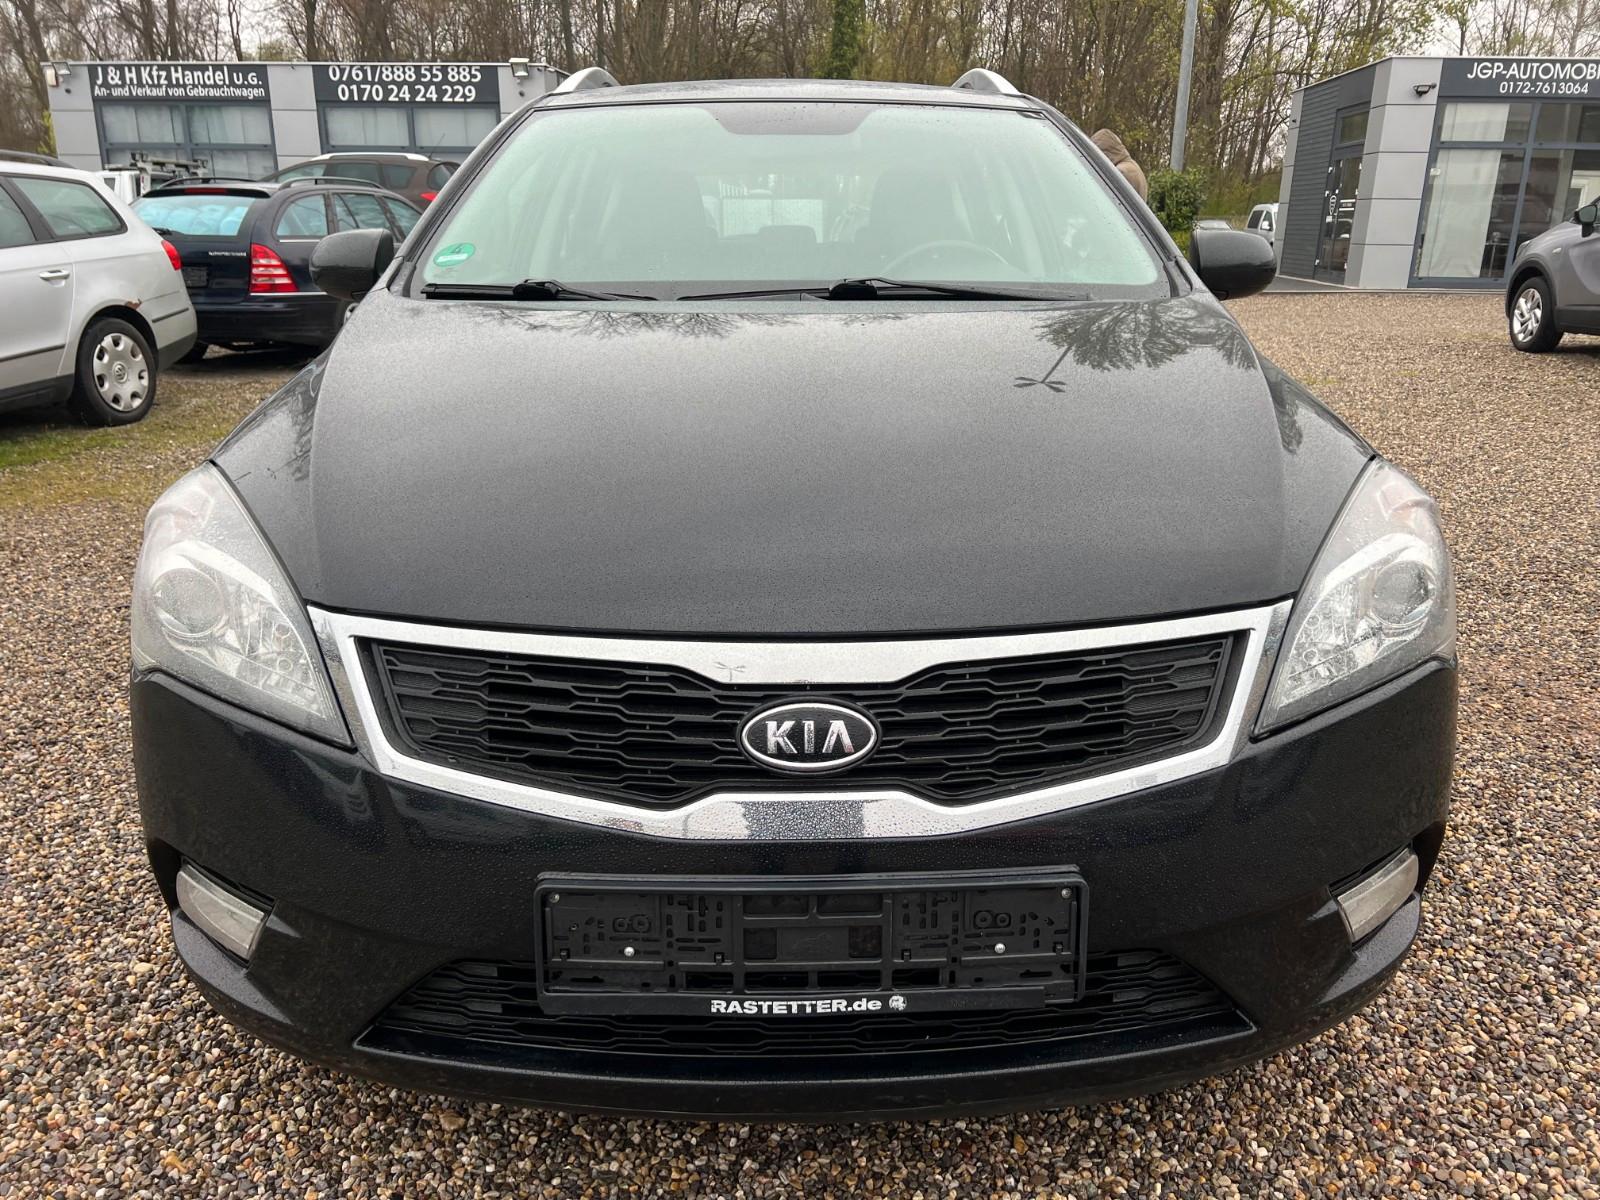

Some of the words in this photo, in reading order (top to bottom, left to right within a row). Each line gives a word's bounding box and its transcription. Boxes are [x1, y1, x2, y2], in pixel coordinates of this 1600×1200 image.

[96, 66, 103, 85] J
[107, 65, 122, 85] &
[124, 66, 138, 85] H
[140, 65, 168, 85] Kfz
[170, 65, 229, 85] Handel
[328, 65, 416, 82] 0761/888
[420, 65, 443, 82] 55
[447, 65, 482, 82] 885
[94, 85, 110, 96] An-
[111, 85, 129, 96] und
[130, 85, 166, 96] Verkauf
[167, 87, 185, 96] von
[186, 85, 265, 99] Gebrauchtwagen
[338, 84, 383, 101] 0170
[388, 85, 410, 101] 24
[415, 85, 437, 101] 24
[442, 86, 476, 102] 229
[1499, 82, 1589, 94] 0172-7613064
[765, 720, 855, 754] KIA
[710, 998, 882, 1014] RASTETTER.de
